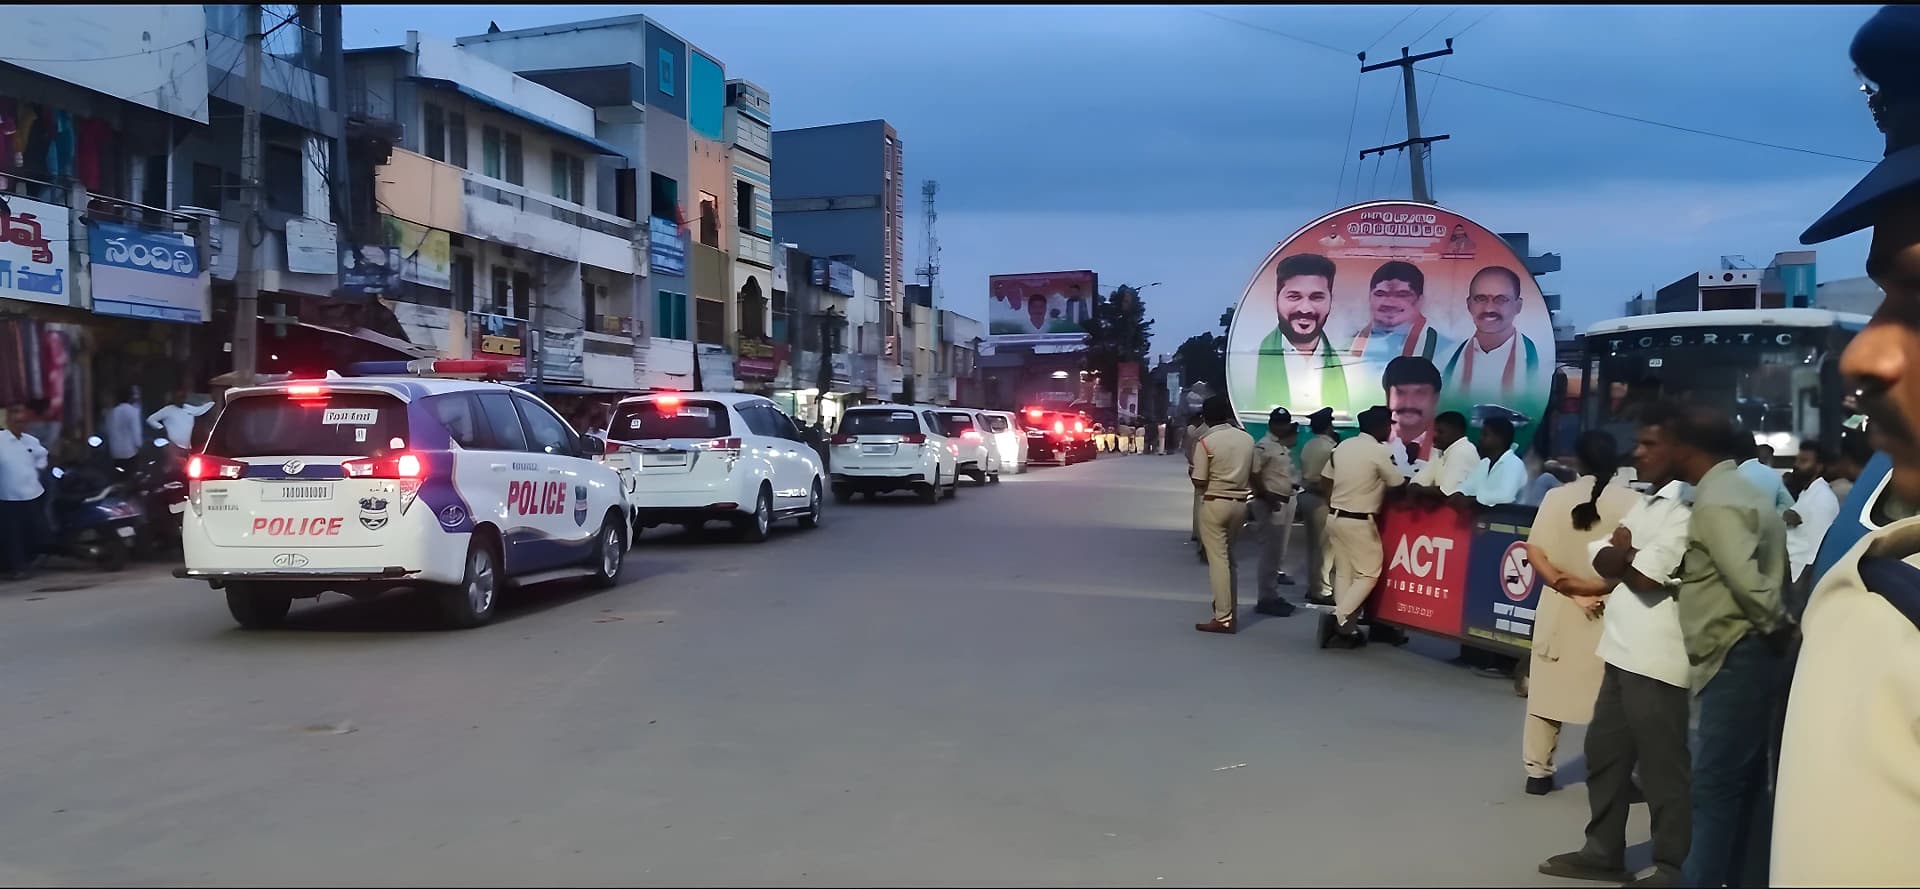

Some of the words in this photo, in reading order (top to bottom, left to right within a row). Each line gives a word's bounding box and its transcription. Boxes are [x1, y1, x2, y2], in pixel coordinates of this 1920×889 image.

[104, 237, 193, 274] నందిని
[507, 480, 567, 516] POLICE
[252, 517, 343, 536] POLICE
[1389, 533, 1454, 580] ACT
